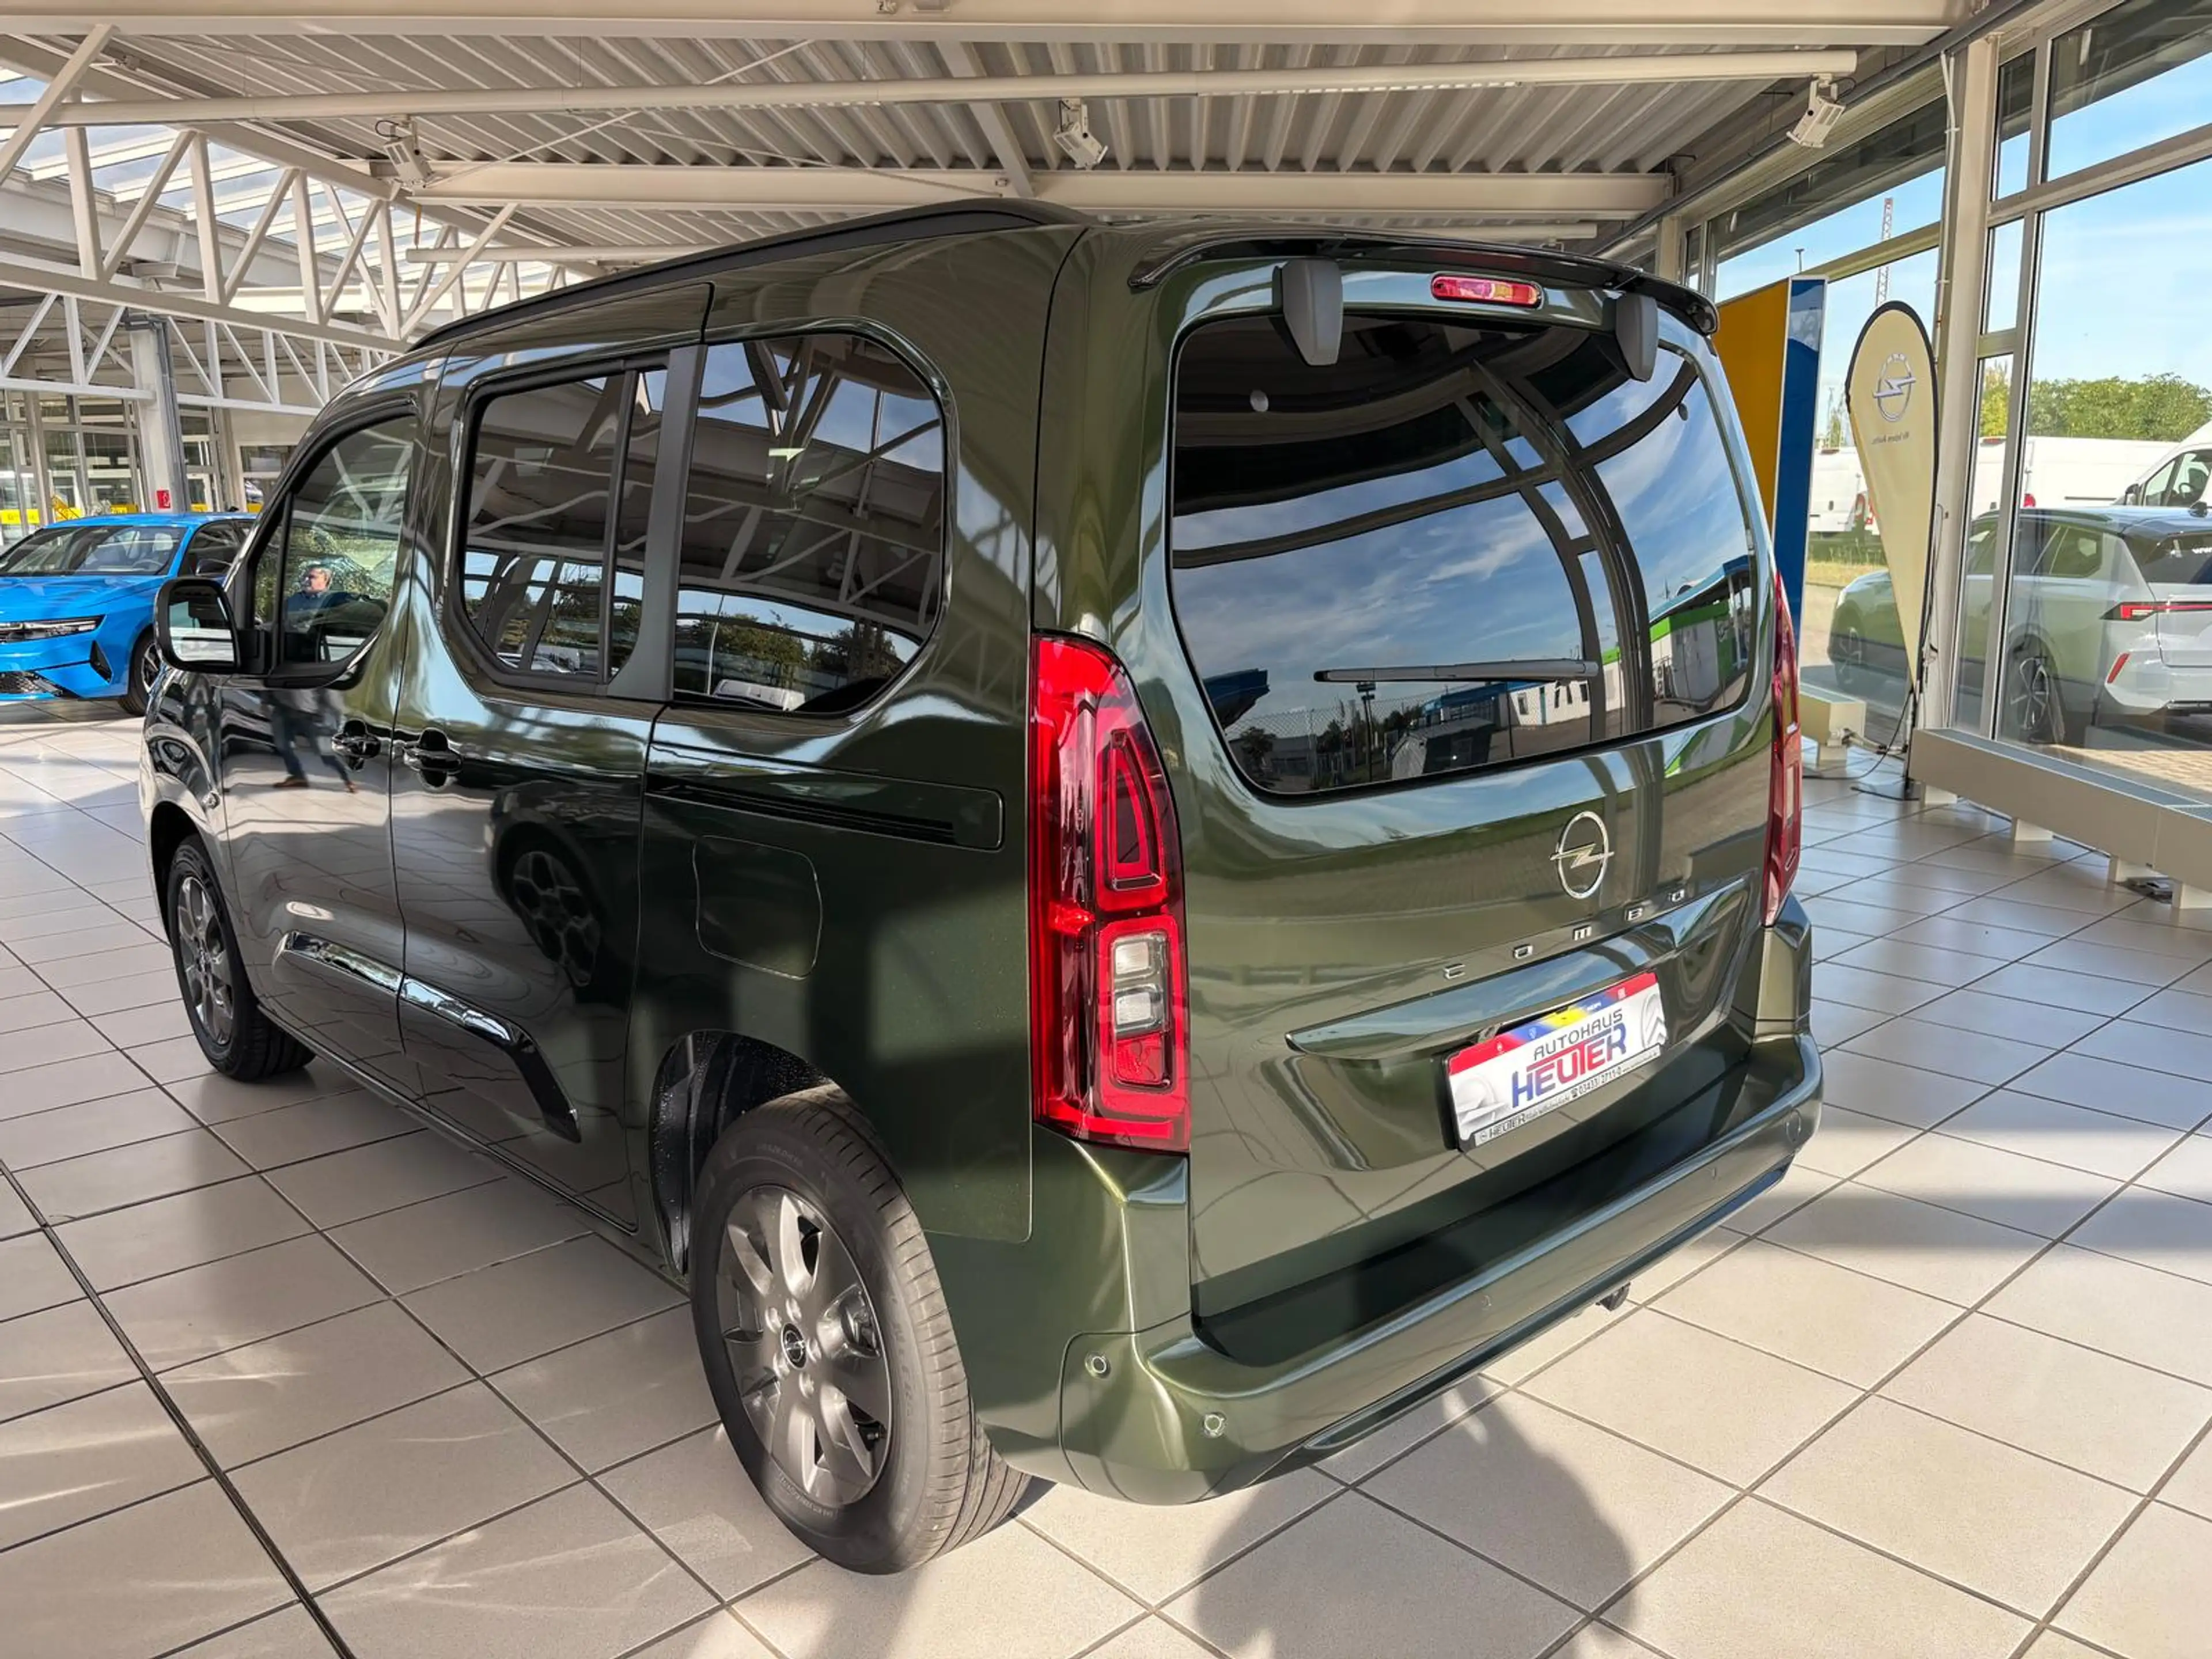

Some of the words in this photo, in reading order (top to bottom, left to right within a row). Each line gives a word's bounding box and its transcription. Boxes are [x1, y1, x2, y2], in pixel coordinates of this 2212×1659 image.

[1444, 889, 1685, 980] COMBO
[1512, 1022, 1627, 1108] HEUTER
[1533, 1008, 1623, 1061] AUTOHAUS
